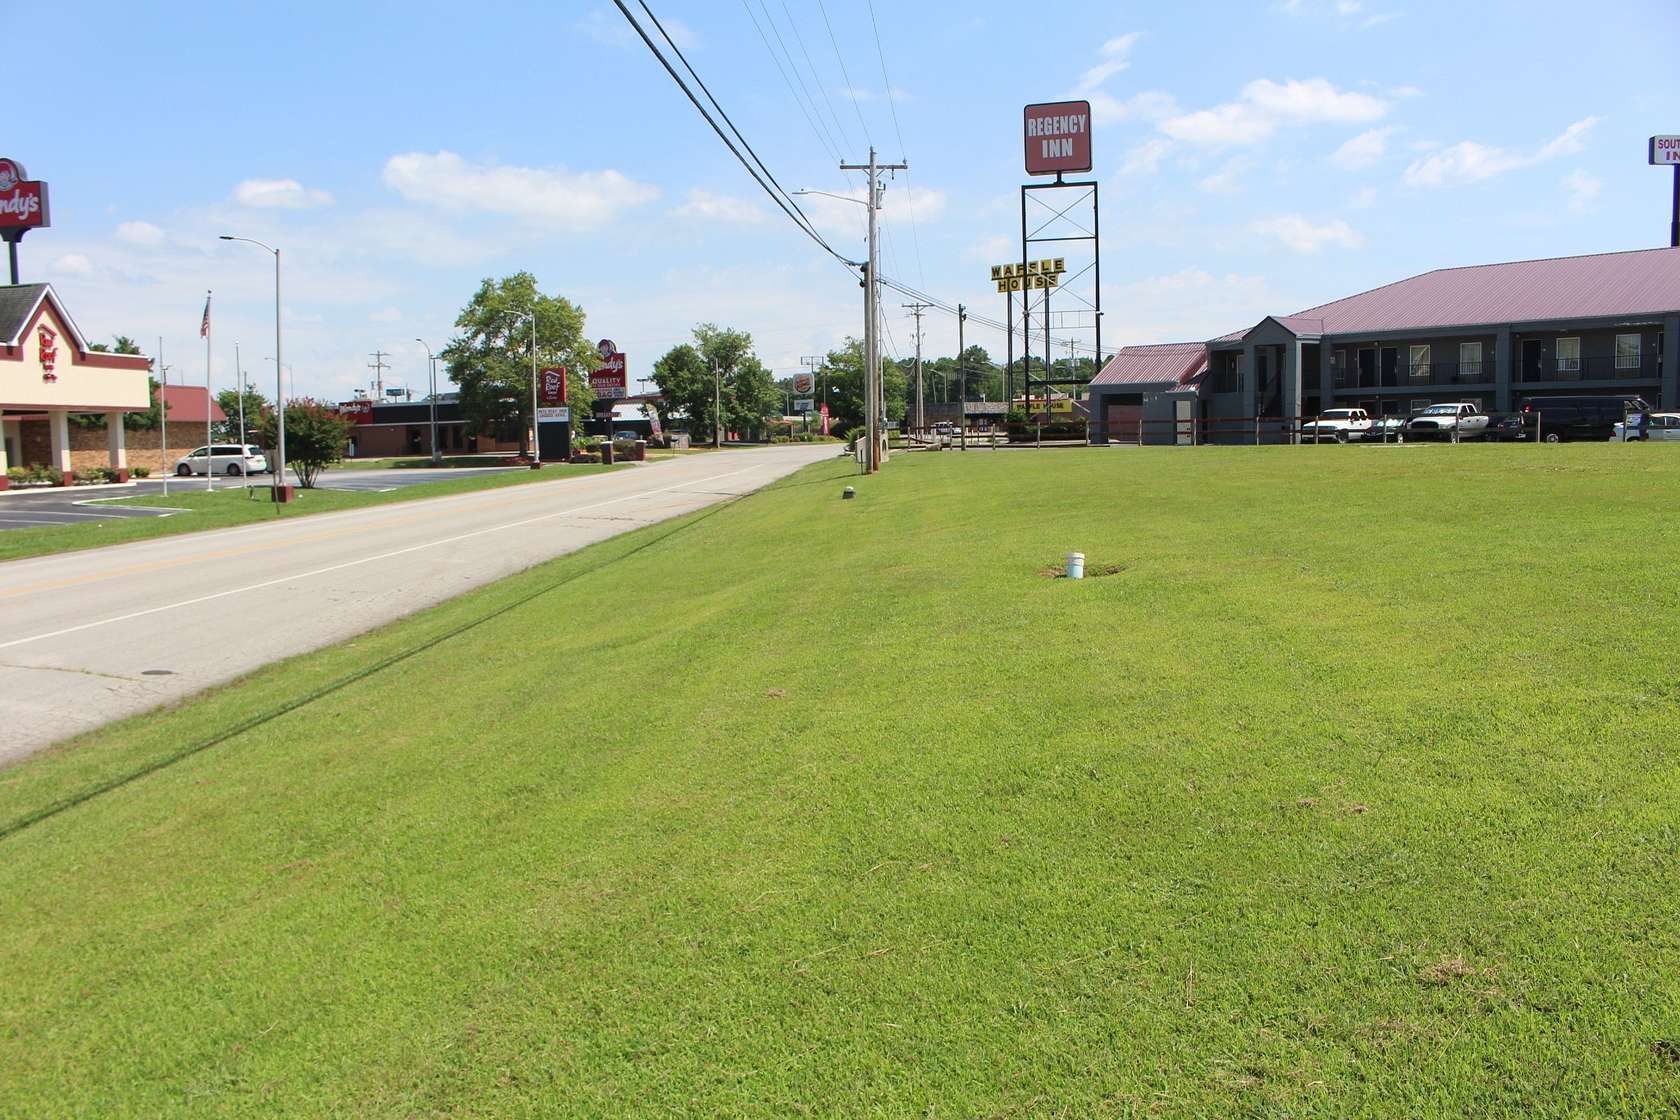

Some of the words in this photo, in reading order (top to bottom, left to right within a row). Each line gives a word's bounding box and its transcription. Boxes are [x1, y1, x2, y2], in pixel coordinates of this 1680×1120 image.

[1028, 114, 1086, 137] REGENCY
[1042, 138, 1073, 158] INN
[991, 259, 1064, 278] WAFFLE
